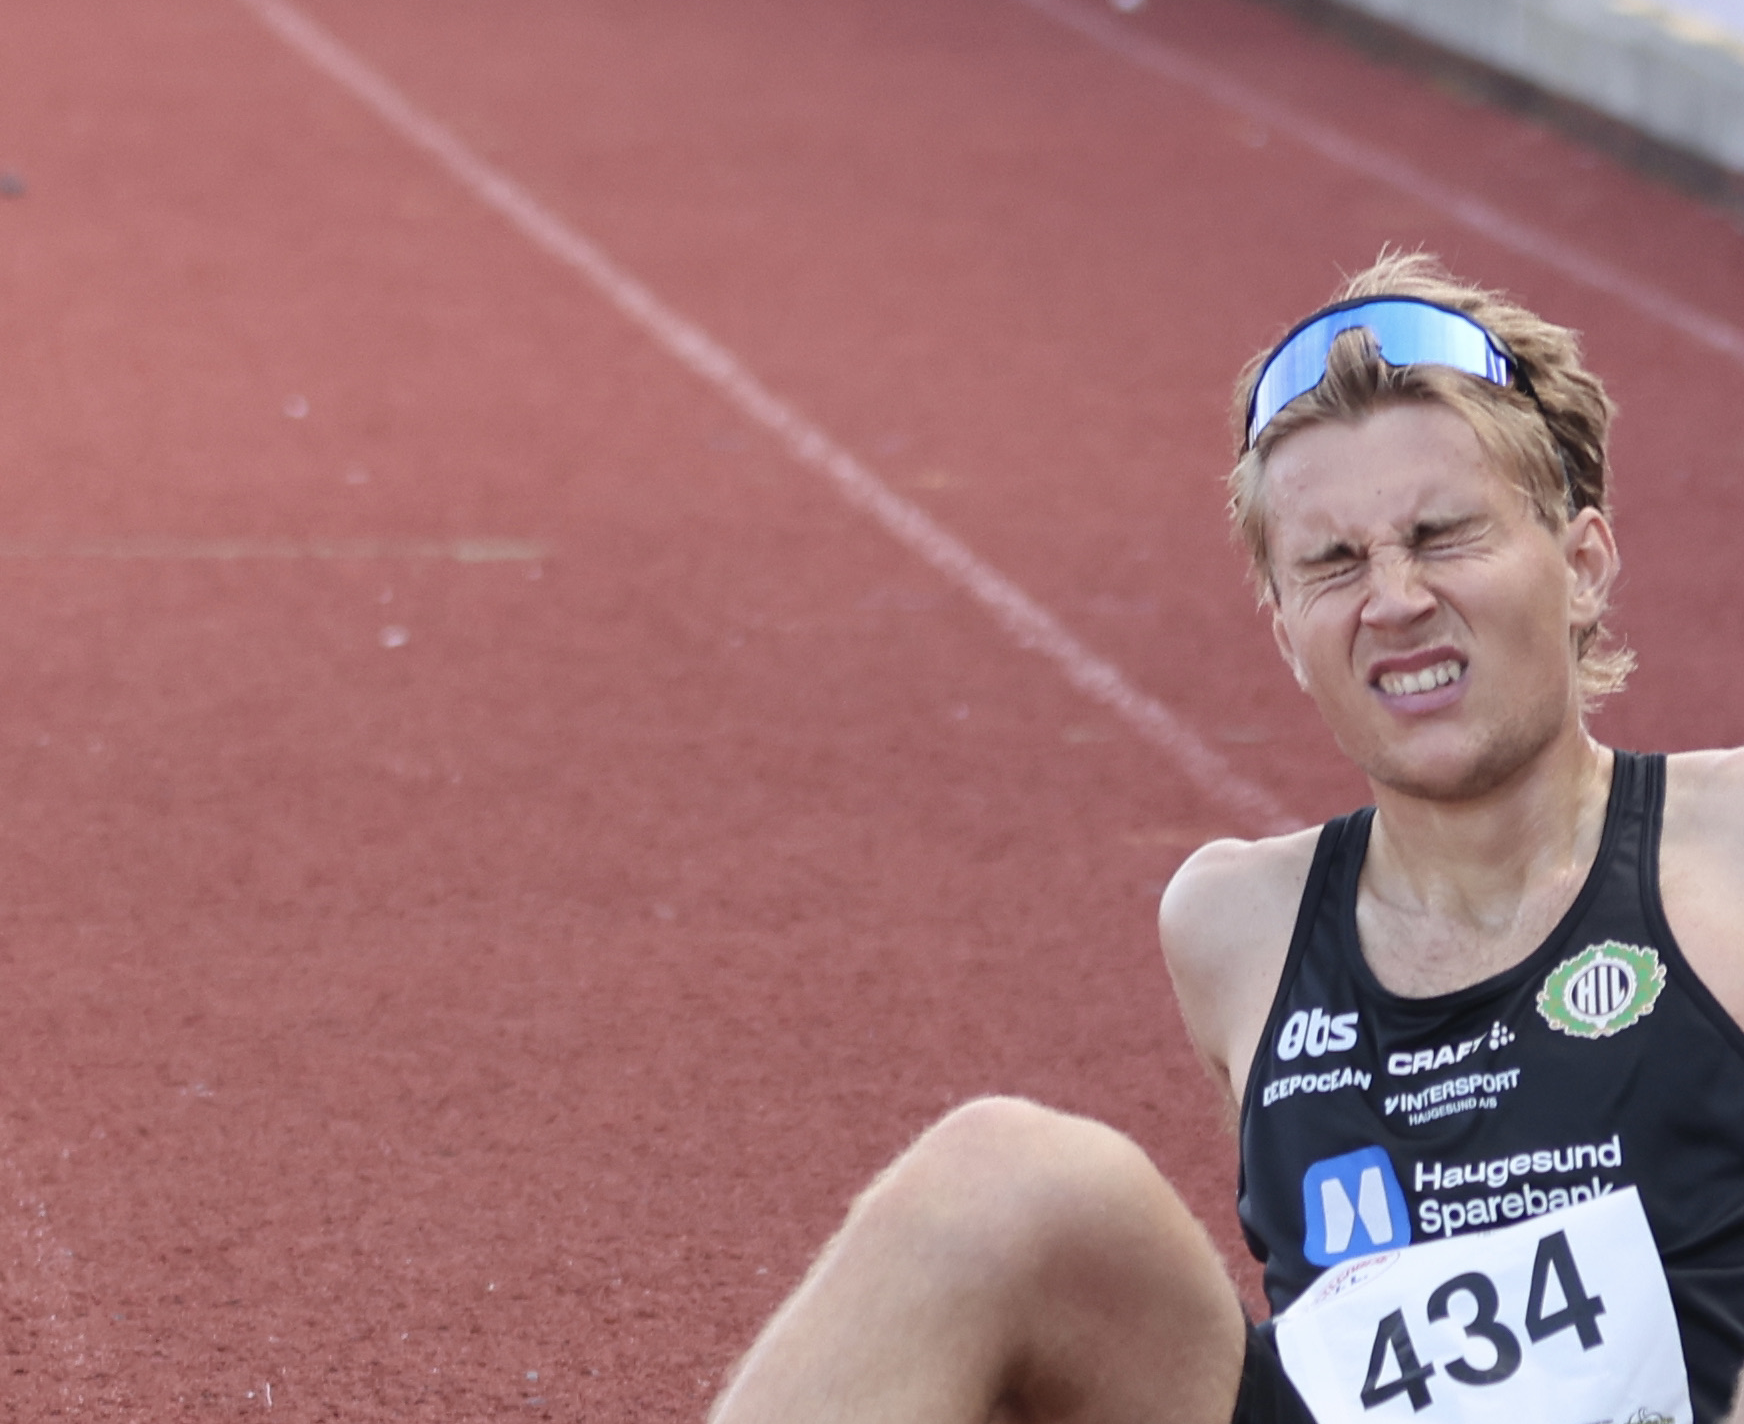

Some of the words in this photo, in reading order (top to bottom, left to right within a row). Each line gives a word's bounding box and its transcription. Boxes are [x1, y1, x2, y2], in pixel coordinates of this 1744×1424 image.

[1576, 964, 1626, 1015] HIL
[1387, 1031, 1489, 1076] CRAFT
[1263, 1066, 1373, 1108] DEEPOCEAN
[1400, 1067, 1521, 1112] INTERSPORT
[1408, 1097, 1477, 1127] HAUGESUND
[1414, 1133, 1623, 1193] Haugesund
[1418, 1175, 1614, 1238] Sparebank
[1360, 1228, 1607, 1414] 434
